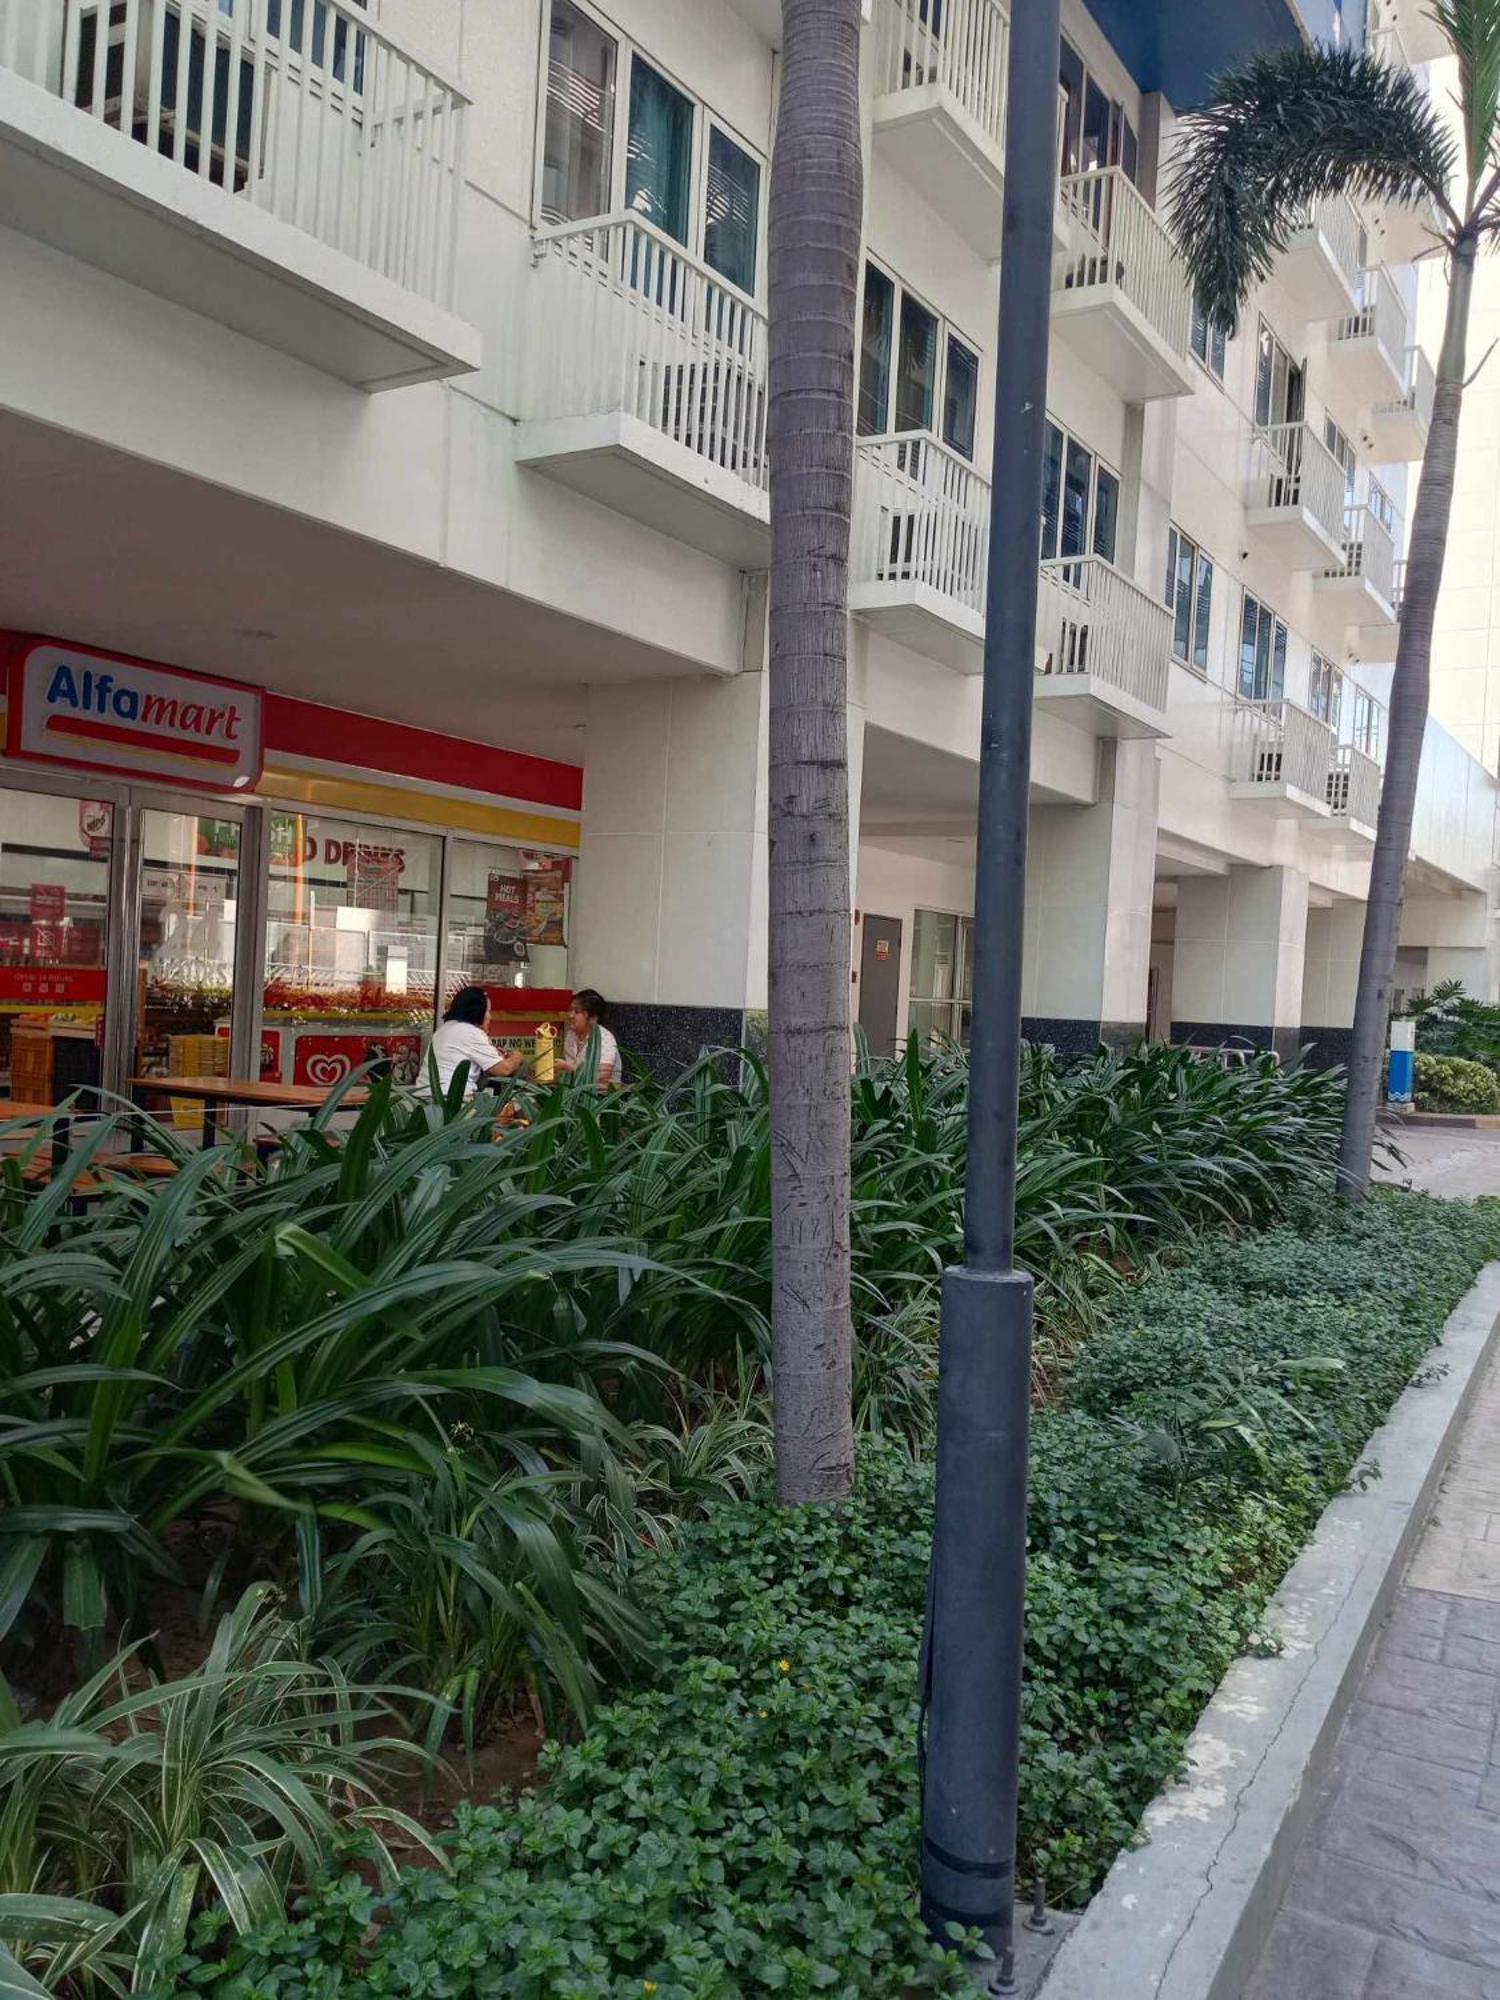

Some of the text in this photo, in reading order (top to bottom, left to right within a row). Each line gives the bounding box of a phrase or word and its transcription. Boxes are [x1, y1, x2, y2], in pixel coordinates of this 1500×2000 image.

[47, 665, 241, 739] Alfamart
[500, 884, 516, 894] HOT
[495, 891, 520, 904] MEALS
